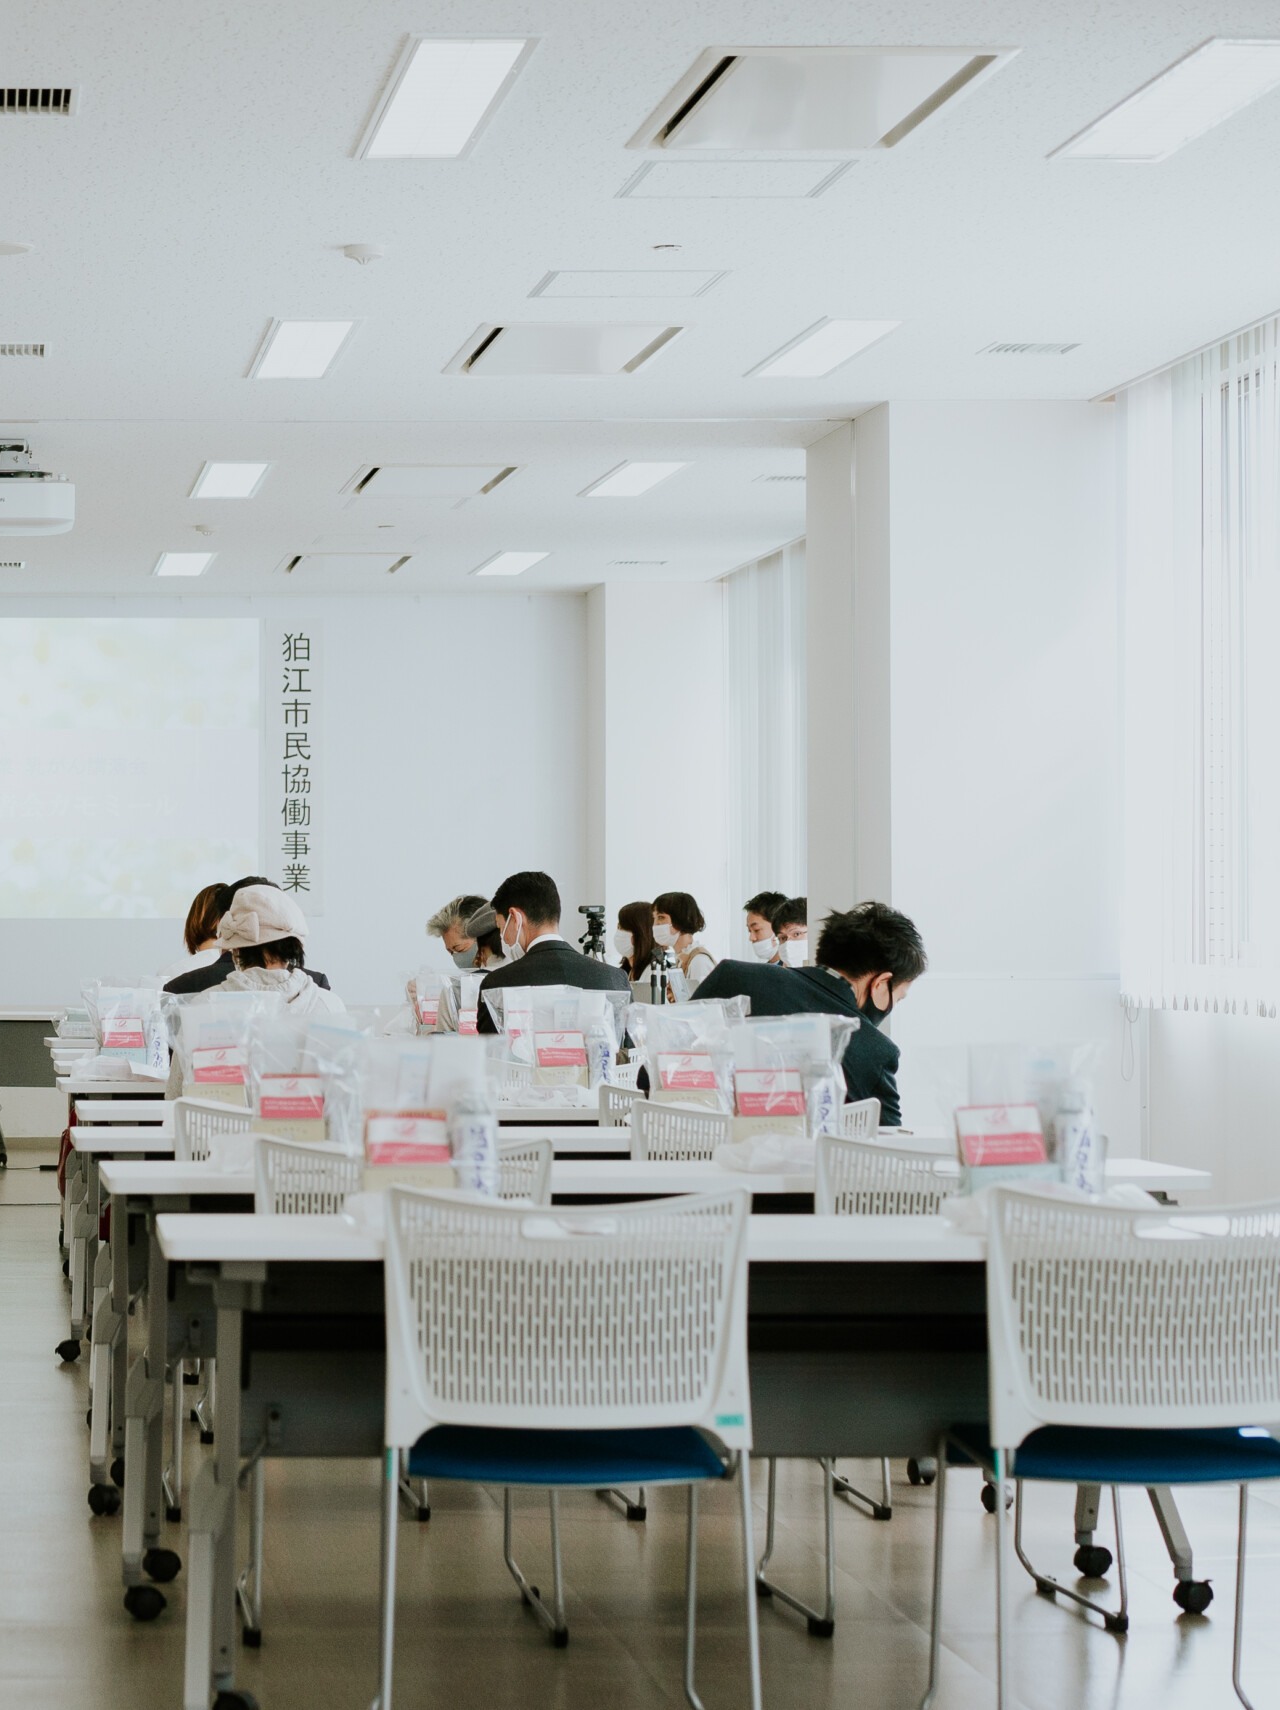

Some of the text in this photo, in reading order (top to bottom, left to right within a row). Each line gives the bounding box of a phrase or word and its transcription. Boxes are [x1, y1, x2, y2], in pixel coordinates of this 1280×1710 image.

[281, 632, 312, 893] 狛江市民協働事業
